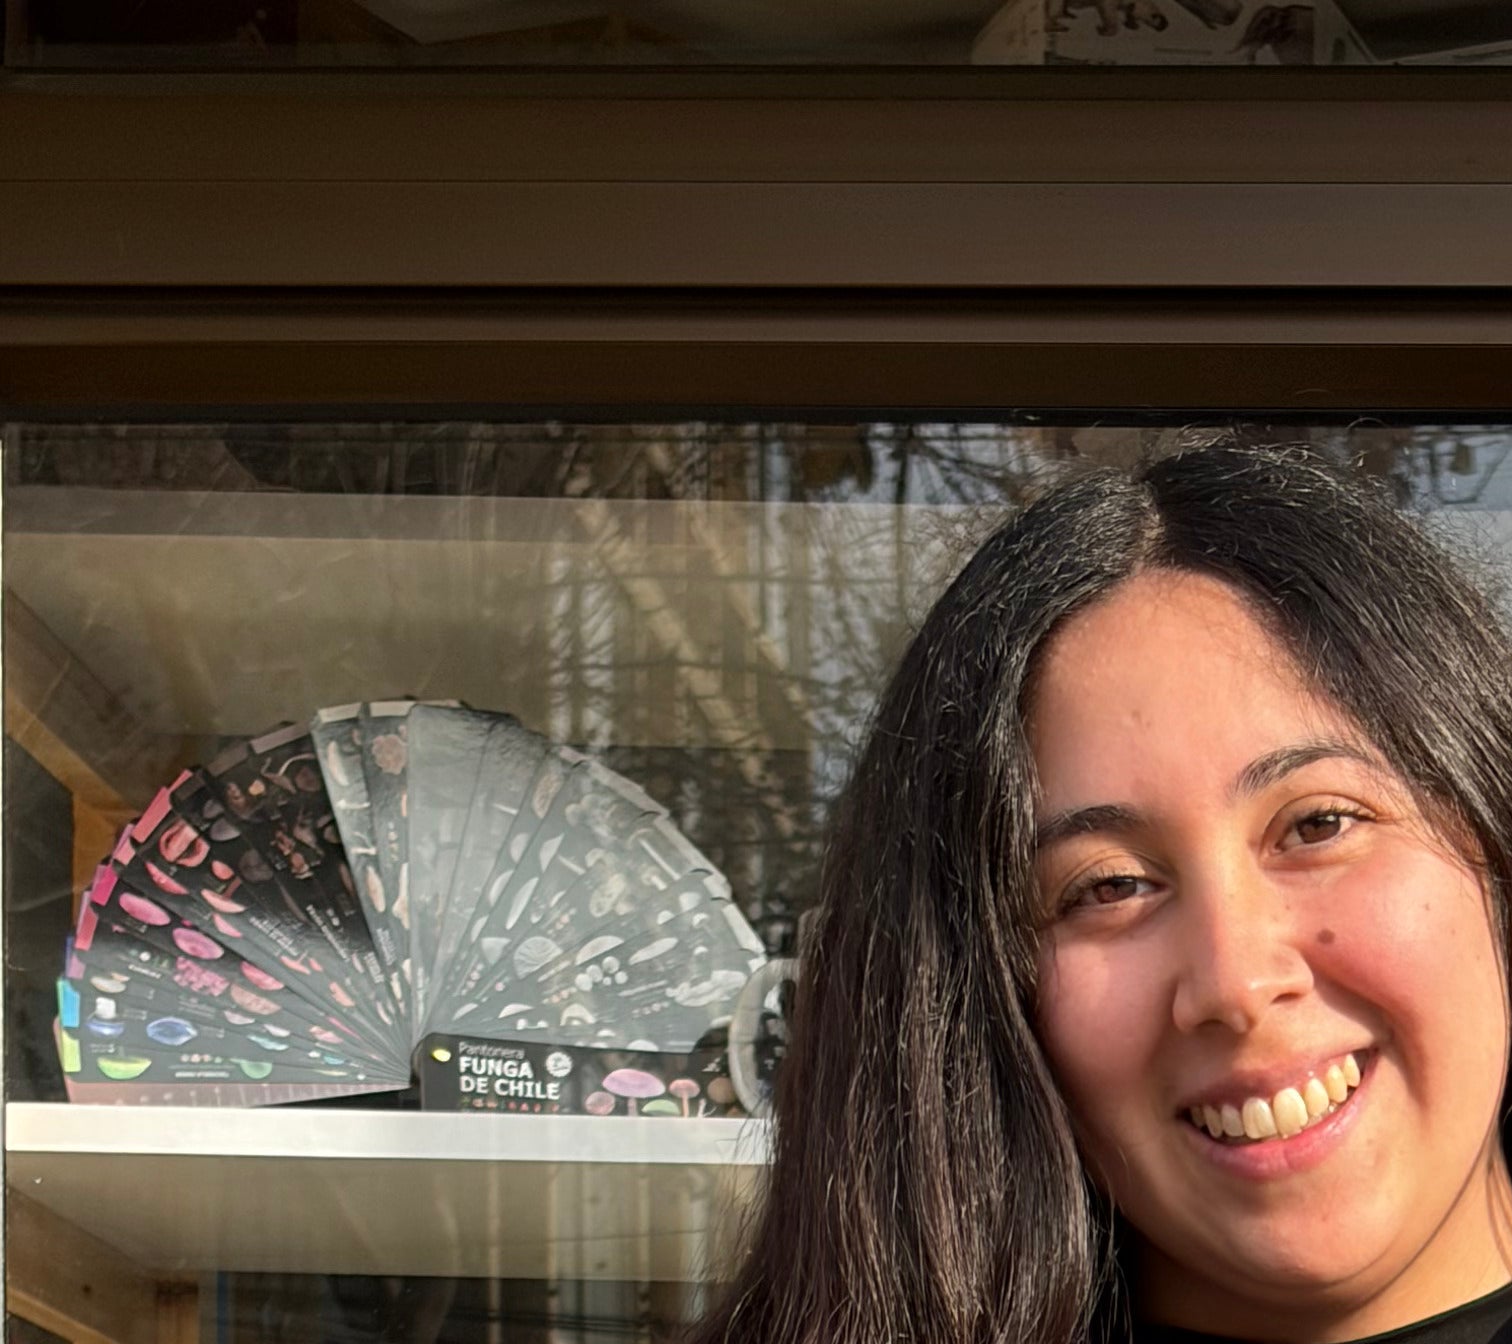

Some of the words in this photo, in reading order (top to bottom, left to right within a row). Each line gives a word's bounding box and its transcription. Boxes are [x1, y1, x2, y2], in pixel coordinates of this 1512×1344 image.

[459, 1057, 533, 1078] FUNGA
[460, 1075, 489, 1093] DE
[495, 1078, 560, 1099] CHILE
